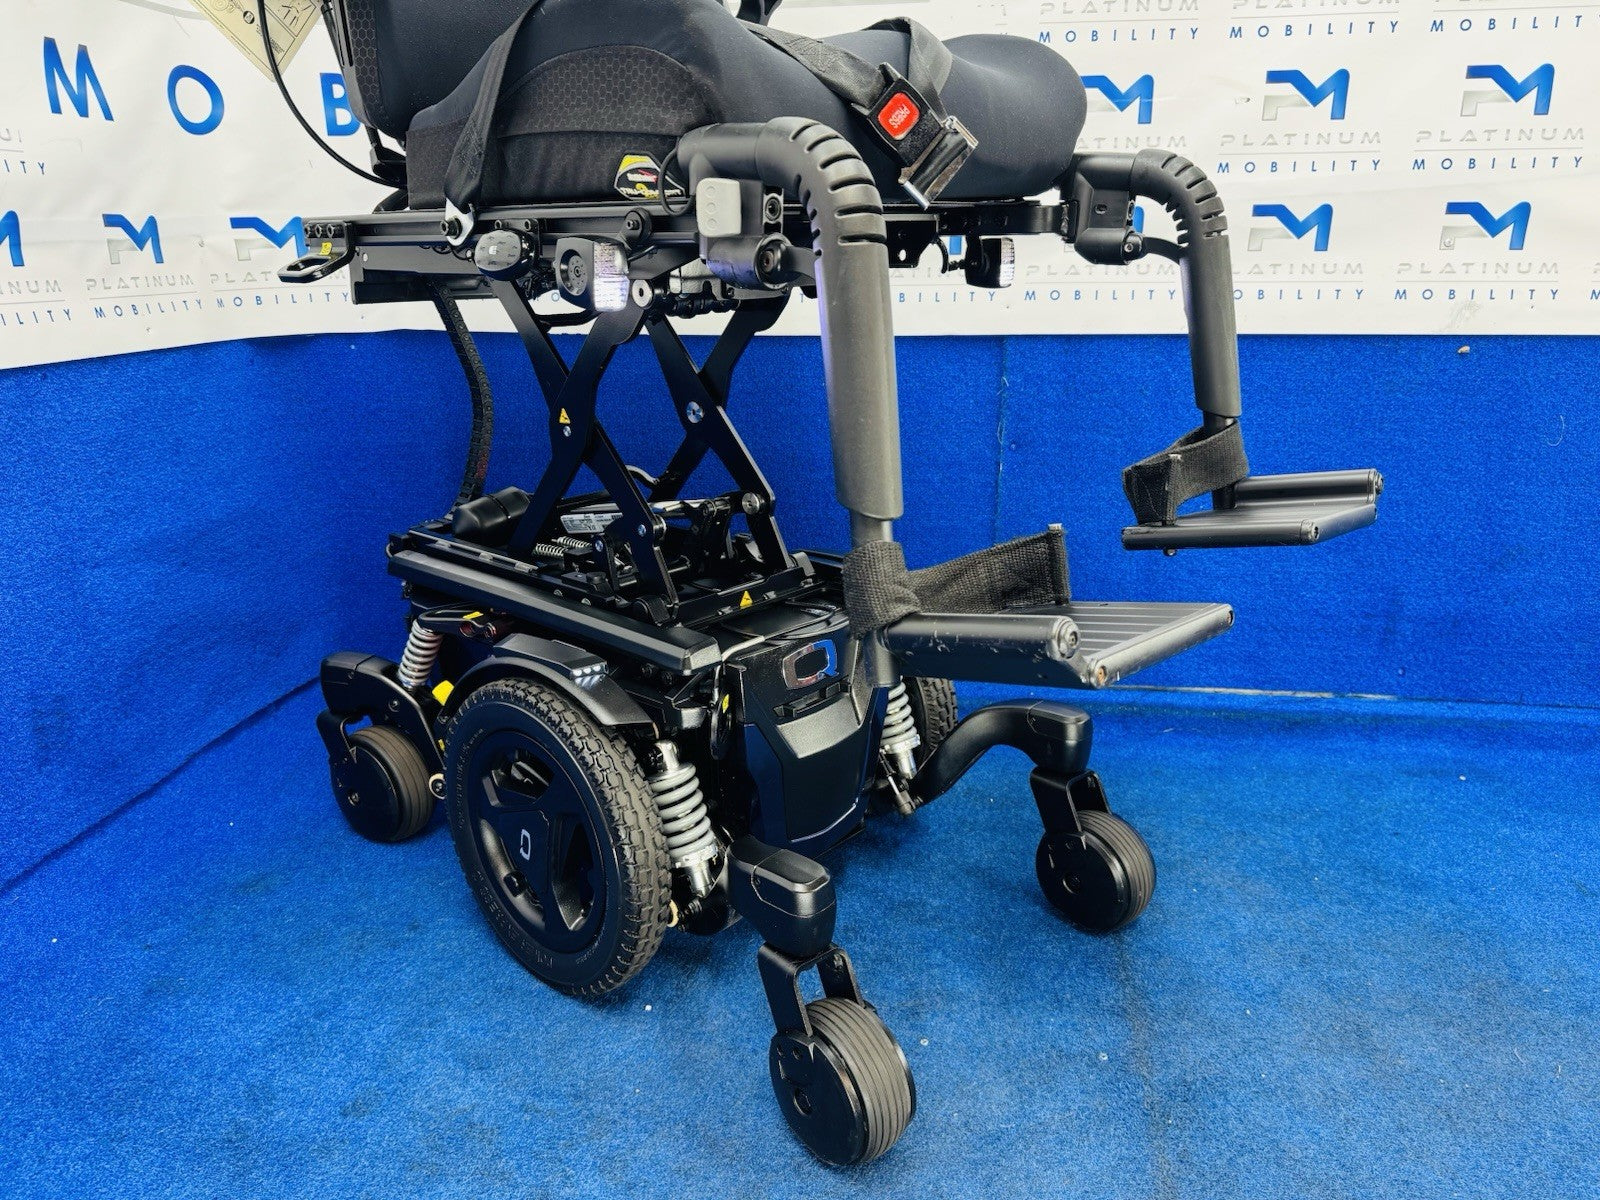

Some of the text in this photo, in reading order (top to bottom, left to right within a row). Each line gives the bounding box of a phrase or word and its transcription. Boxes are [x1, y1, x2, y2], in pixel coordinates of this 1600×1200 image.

[1230, 21, 1398, 38] MOBILITY
[1431, 14, 1600, 32] MOBILIT
[1038, 28, 1198, 43] MOBILITY
[1220, 132, 1381, 146] PLATINUM
[1416, 128, 1584, 142] PLATINUM
[1217, 160, 1380, 173] MOBILITY
[1412, 157, 1583, 170] MOBILITY
[1026, 264, 1175, 276] PLATINUM
[1397, 262, 1558, 274] PLATINUM
[86, 275, 195, 291] PLATINUM
[216, 292, 349, 309] MOBILITY
[1024, 290, 1175, 301] MOBILITY
[1394, 289, 1559, 300] MOBILITY
[94, 299, 203, 319] MOBILITY
